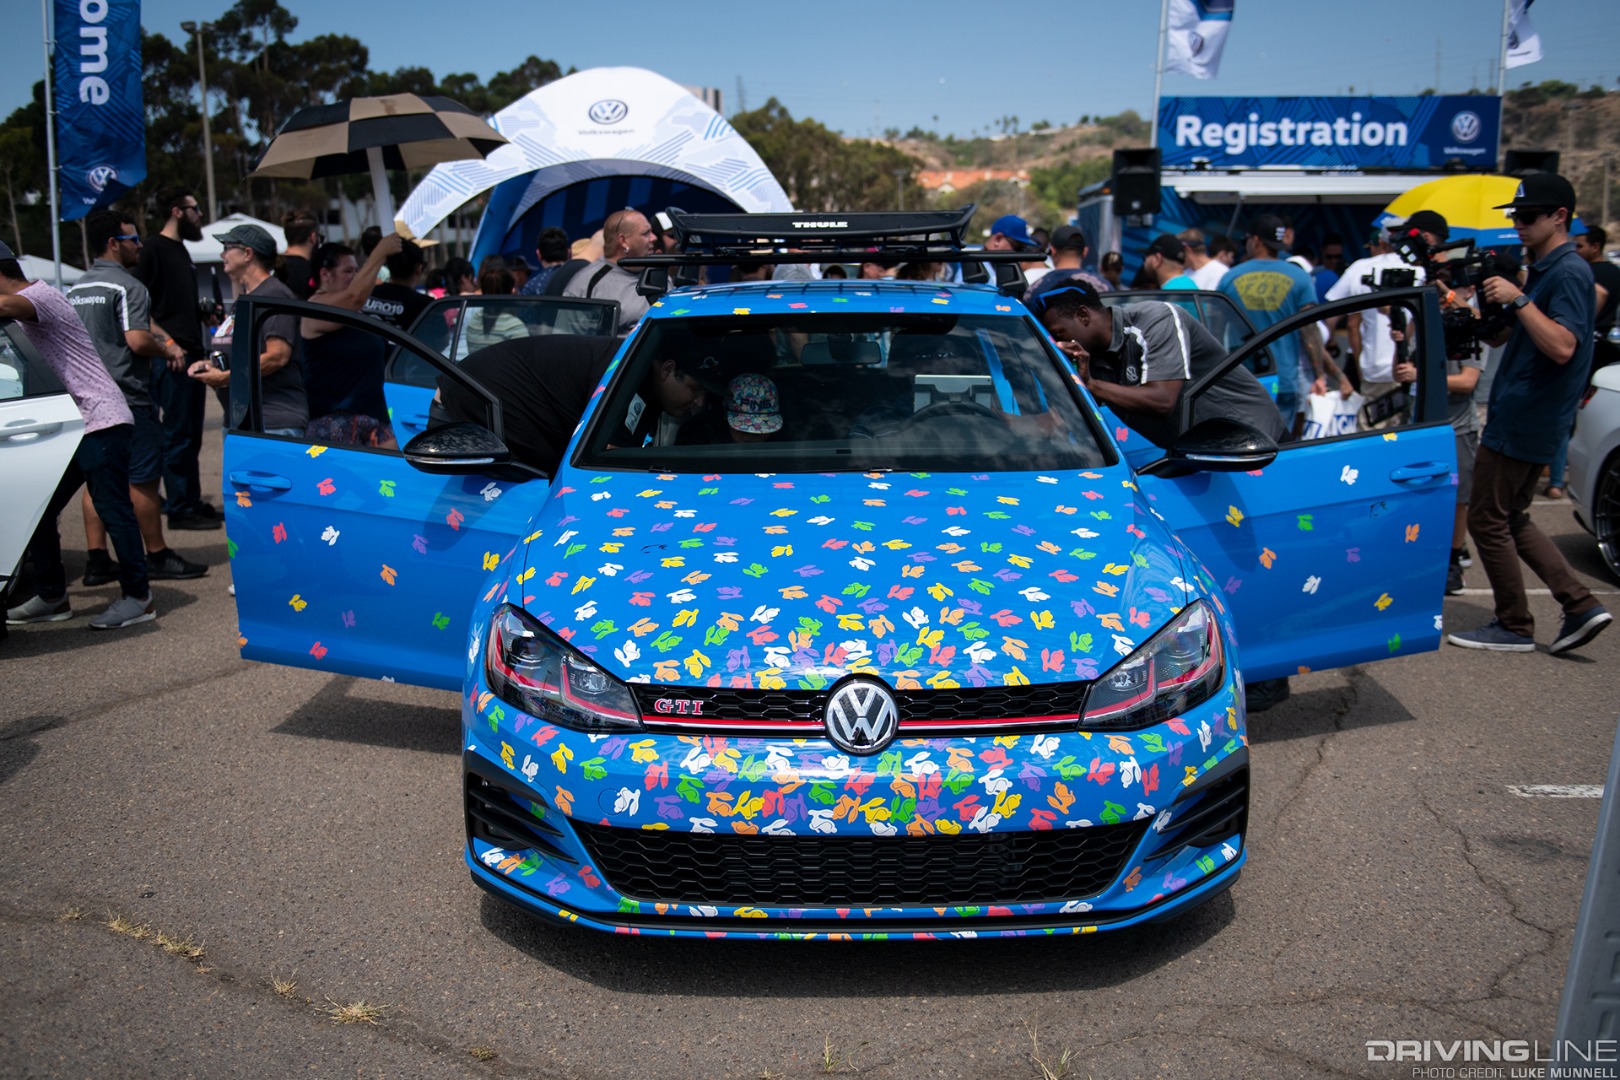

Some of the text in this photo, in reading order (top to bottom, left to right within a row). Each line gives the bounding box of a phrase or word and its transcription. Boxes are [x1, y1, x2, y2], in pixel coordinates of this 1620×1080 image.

[1176, 112, 1408, 155] Registration
[362, 298, 405, 315] URO19
[654, 698, 704, 715] GTI
